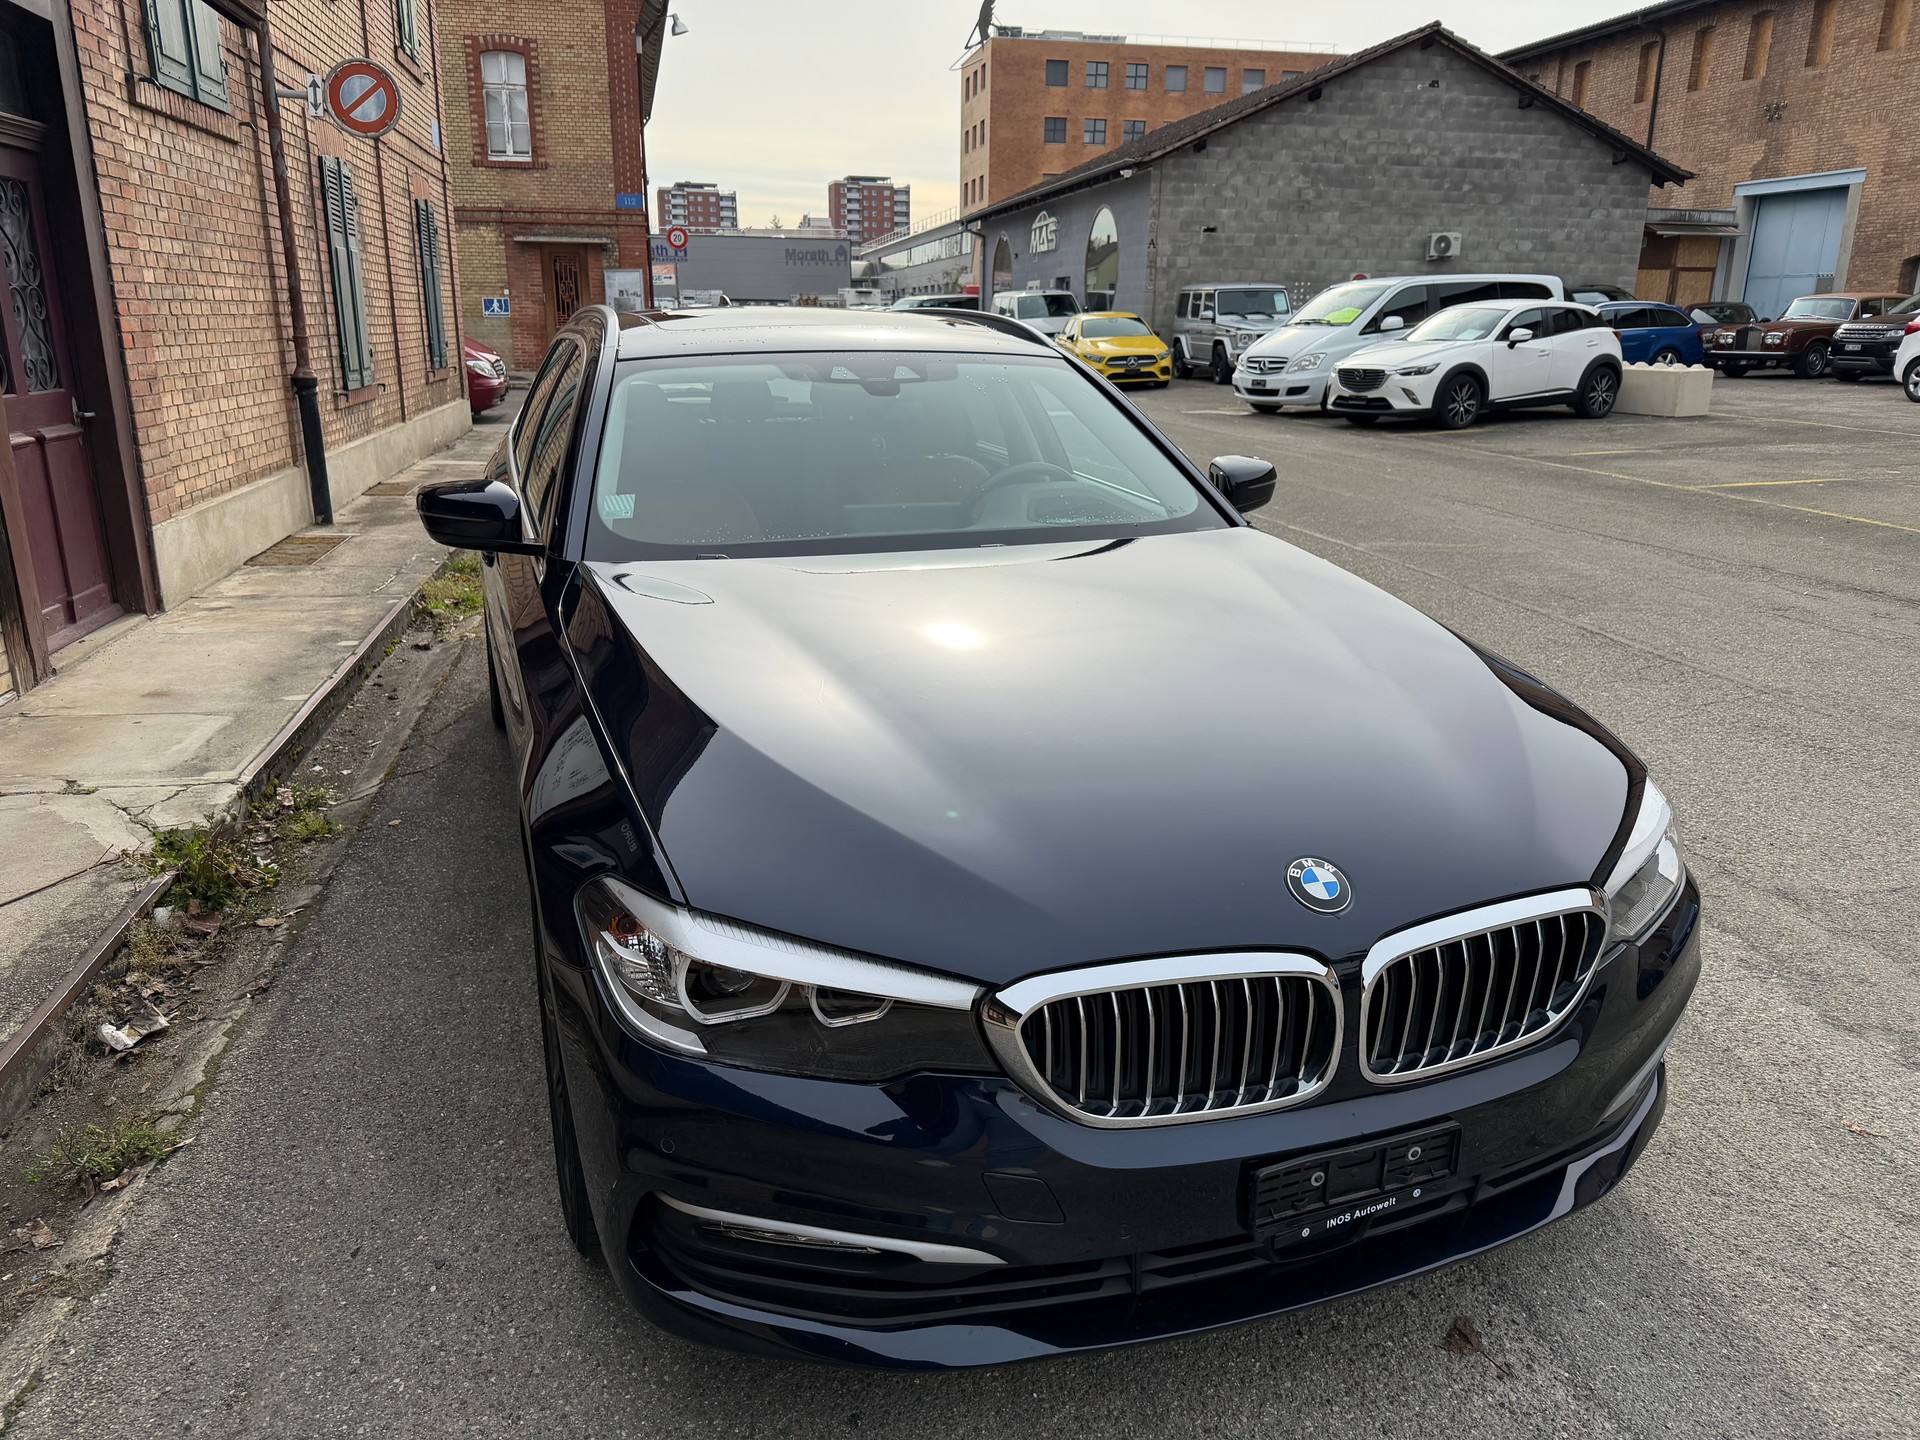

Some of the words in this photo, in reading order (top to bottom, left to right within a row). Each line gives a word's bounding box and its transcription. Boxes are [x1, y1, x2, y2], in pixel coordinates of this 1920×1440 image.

[624, 197, 637, 206] 112
[673, 234, 682, 243] 20
[1029, 216, 1058, 254] MAS
[784, 247, 830, 261] Morath
[1289, 859, 1337, 878] BMW
[1326, 1213, 1351, 1229] INOS
[1353, 1197, 1397, 1219] Autowelt
